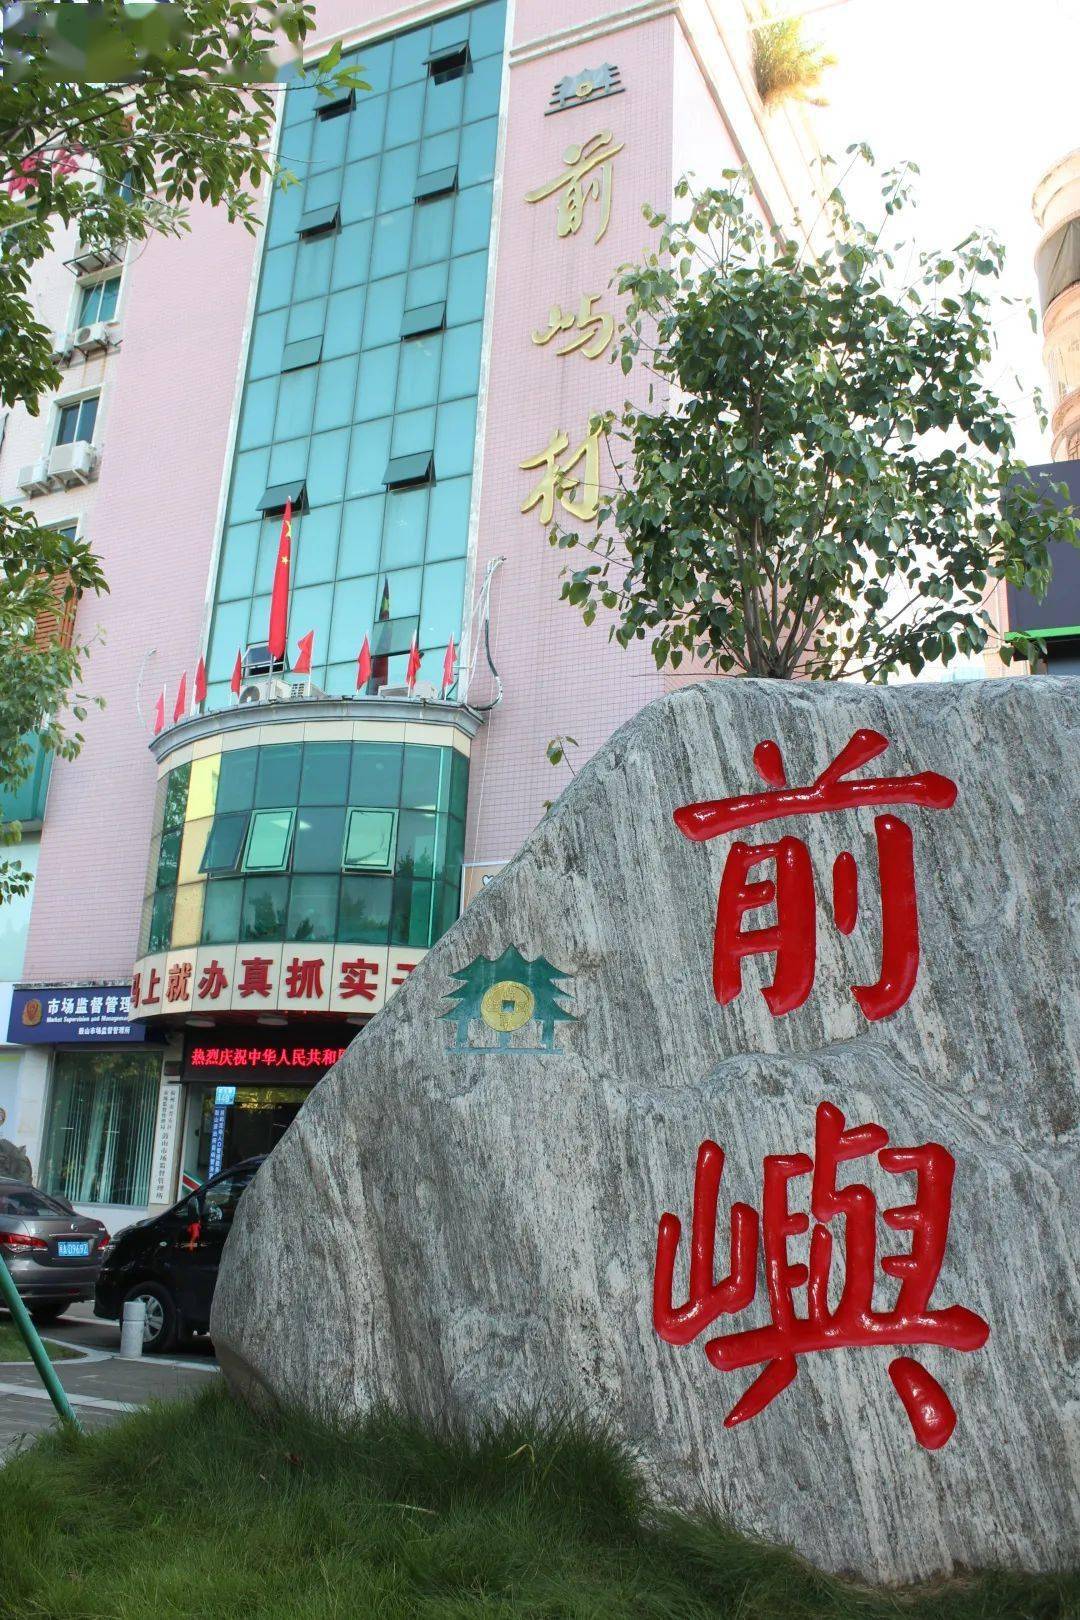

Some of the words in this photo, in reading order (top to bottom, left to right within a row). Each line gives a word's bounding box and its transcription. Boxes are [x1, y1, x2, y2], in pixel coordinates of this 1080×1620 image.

[519, 130, 625, 525] 前屿村
[47, 996, 130, 1015] 市场监督管理
